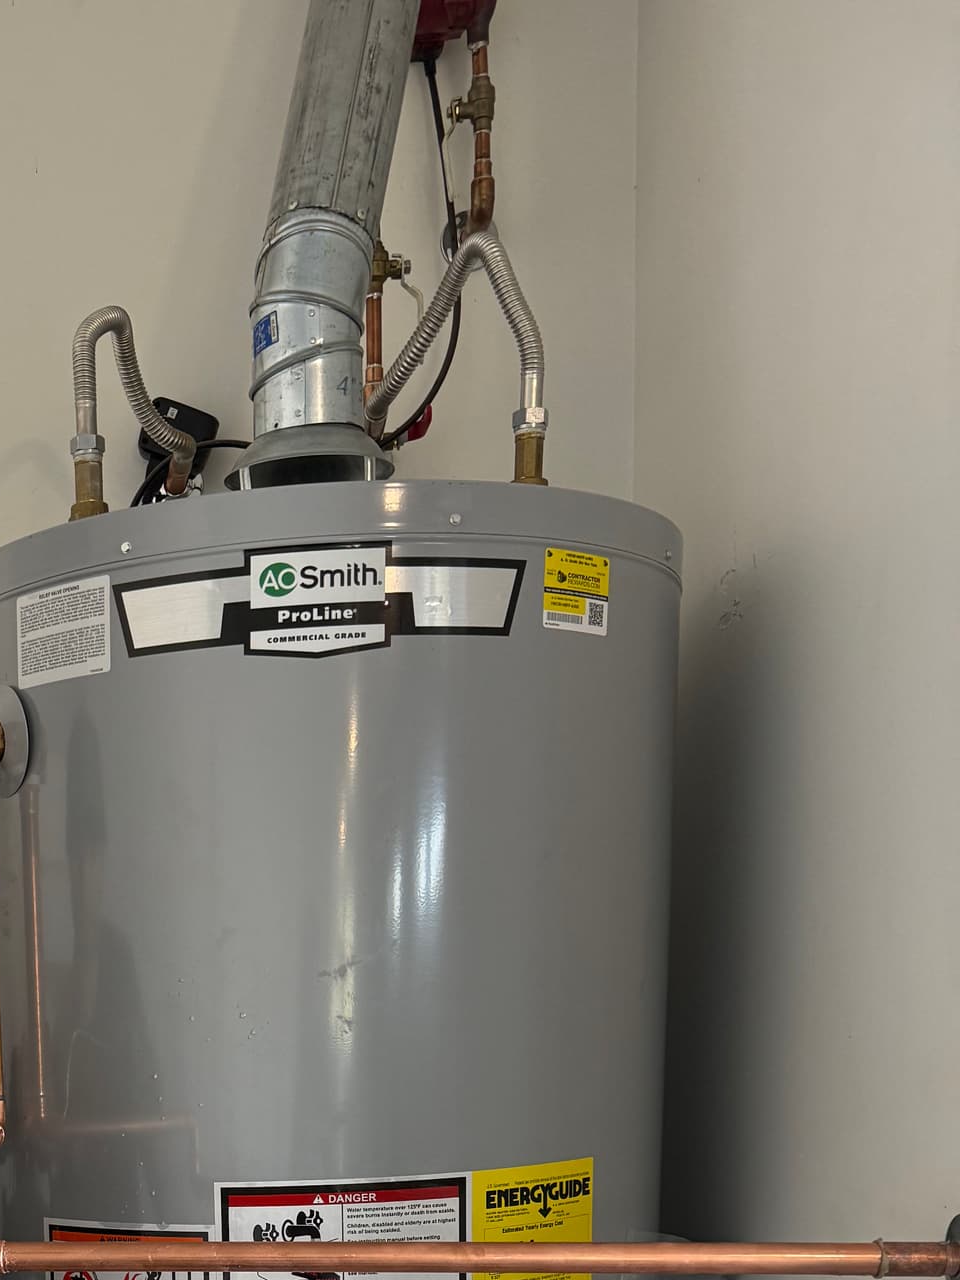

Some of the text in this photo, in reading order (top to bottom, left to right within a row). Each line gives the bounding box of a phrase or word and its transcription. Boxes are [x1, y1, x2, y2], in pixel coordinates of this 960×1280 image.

[278, 607, 353, 623] ProLine
[267, 634, 330, 643] COMMERCIAL
[328, 1193, 377, 1204] DANGER
[486, 1177, 590, 1209] ENERGYGUIDE
